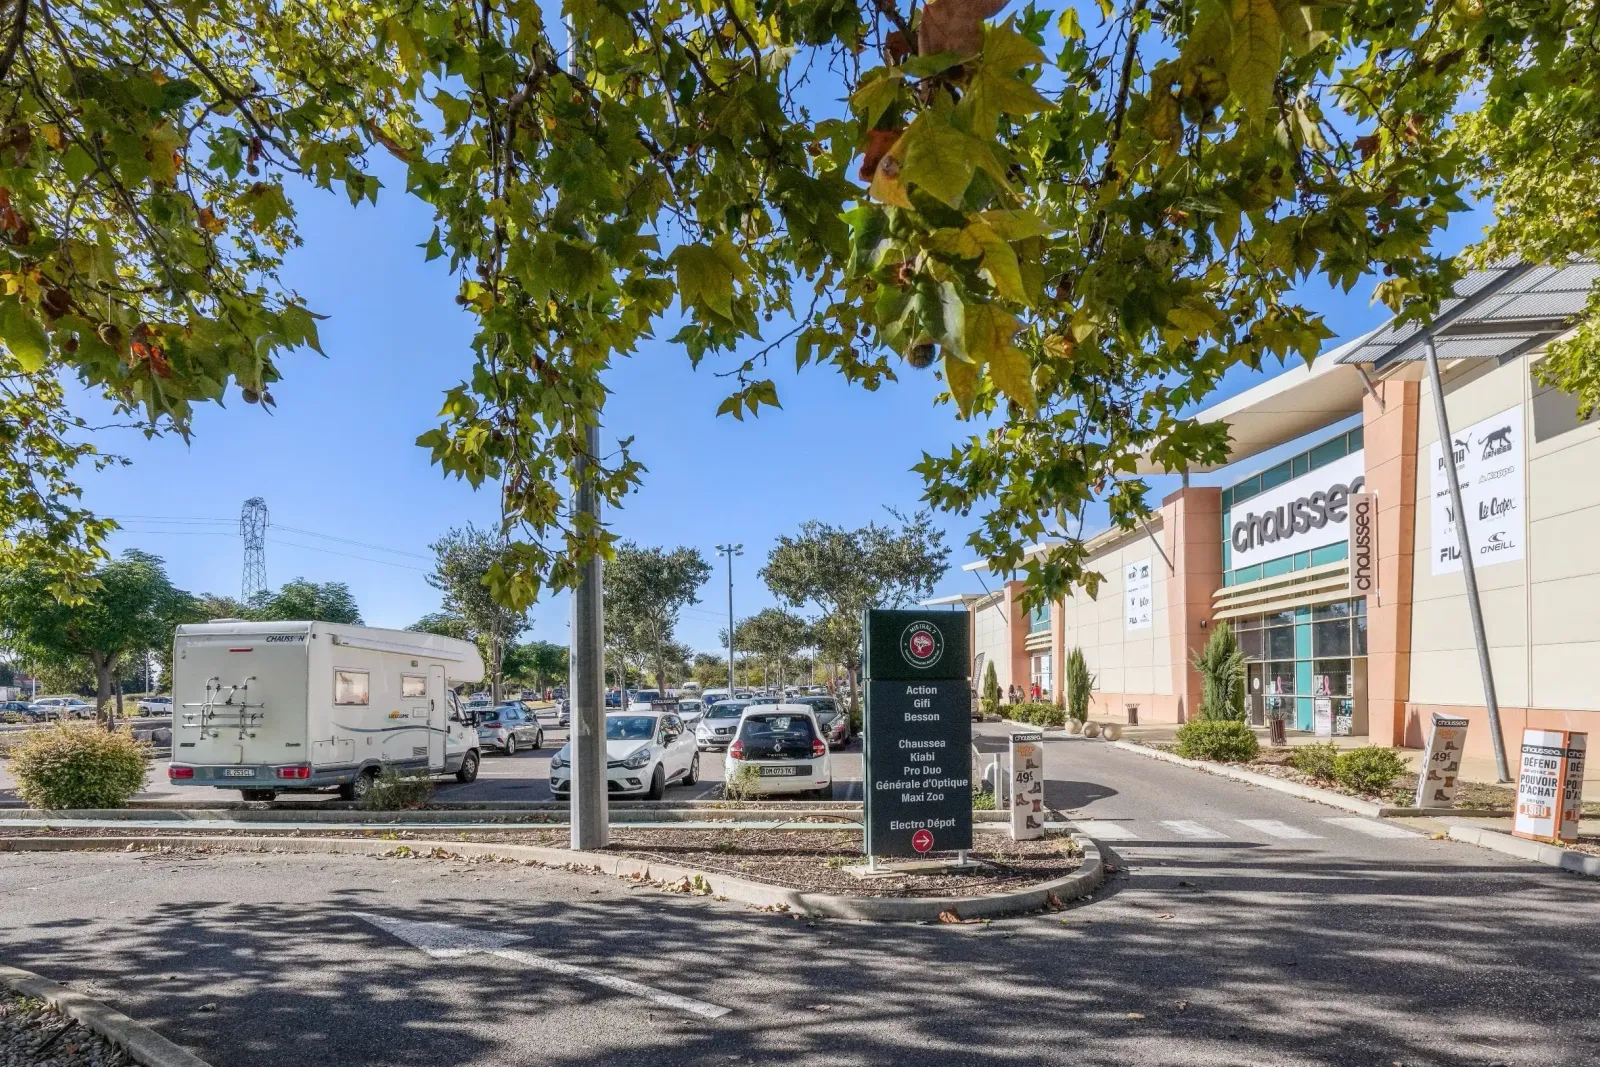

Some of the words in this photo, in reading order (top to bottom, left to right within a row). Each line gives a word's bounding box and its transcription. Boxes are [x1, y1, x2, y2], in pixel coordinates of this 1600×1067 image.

[1438, 448, 1465, 471] PMA
[1487, 465, 1515, 481] Kappa
[1478, 501, 1489, 521] Lee
[1490, 497, 1517, 517] Cooper
[1354, 501, 1371, 591] chaussea
[1480, 541, 1516, 554] O'NEILL
[909, 623, 931, 633] MISTRAL
[266, 635, 306, 643] CHAUSSN
[906, 685, 938, 695] Action
[913, 699, 931, 708] Gifi
[904, 712, 940, 722] Besson
[898, 739, 946, 749] Chaussea
[1522, 746, 1562, 756] chaussea
[910, 752, 935, 762] Kiabi
[1523, 757, 1557, 769] DÉFEND
[903, 766, 921, 776] Pro
[922, 765, 942, 775] Duo
[876, 779, 921, 790] Générale
[922, 778, 969, 790] d'Optique
[1520, 774, 1558, 788] POUVOIR
[1520, 784, 1557, 798] D'ACHAT
[901, 793, 925, 803] Maxi
[926, 792, 945, 802] Zoo
[890, 820, 925, 830] Electro
[927, 818, 956, 829] Dépot
